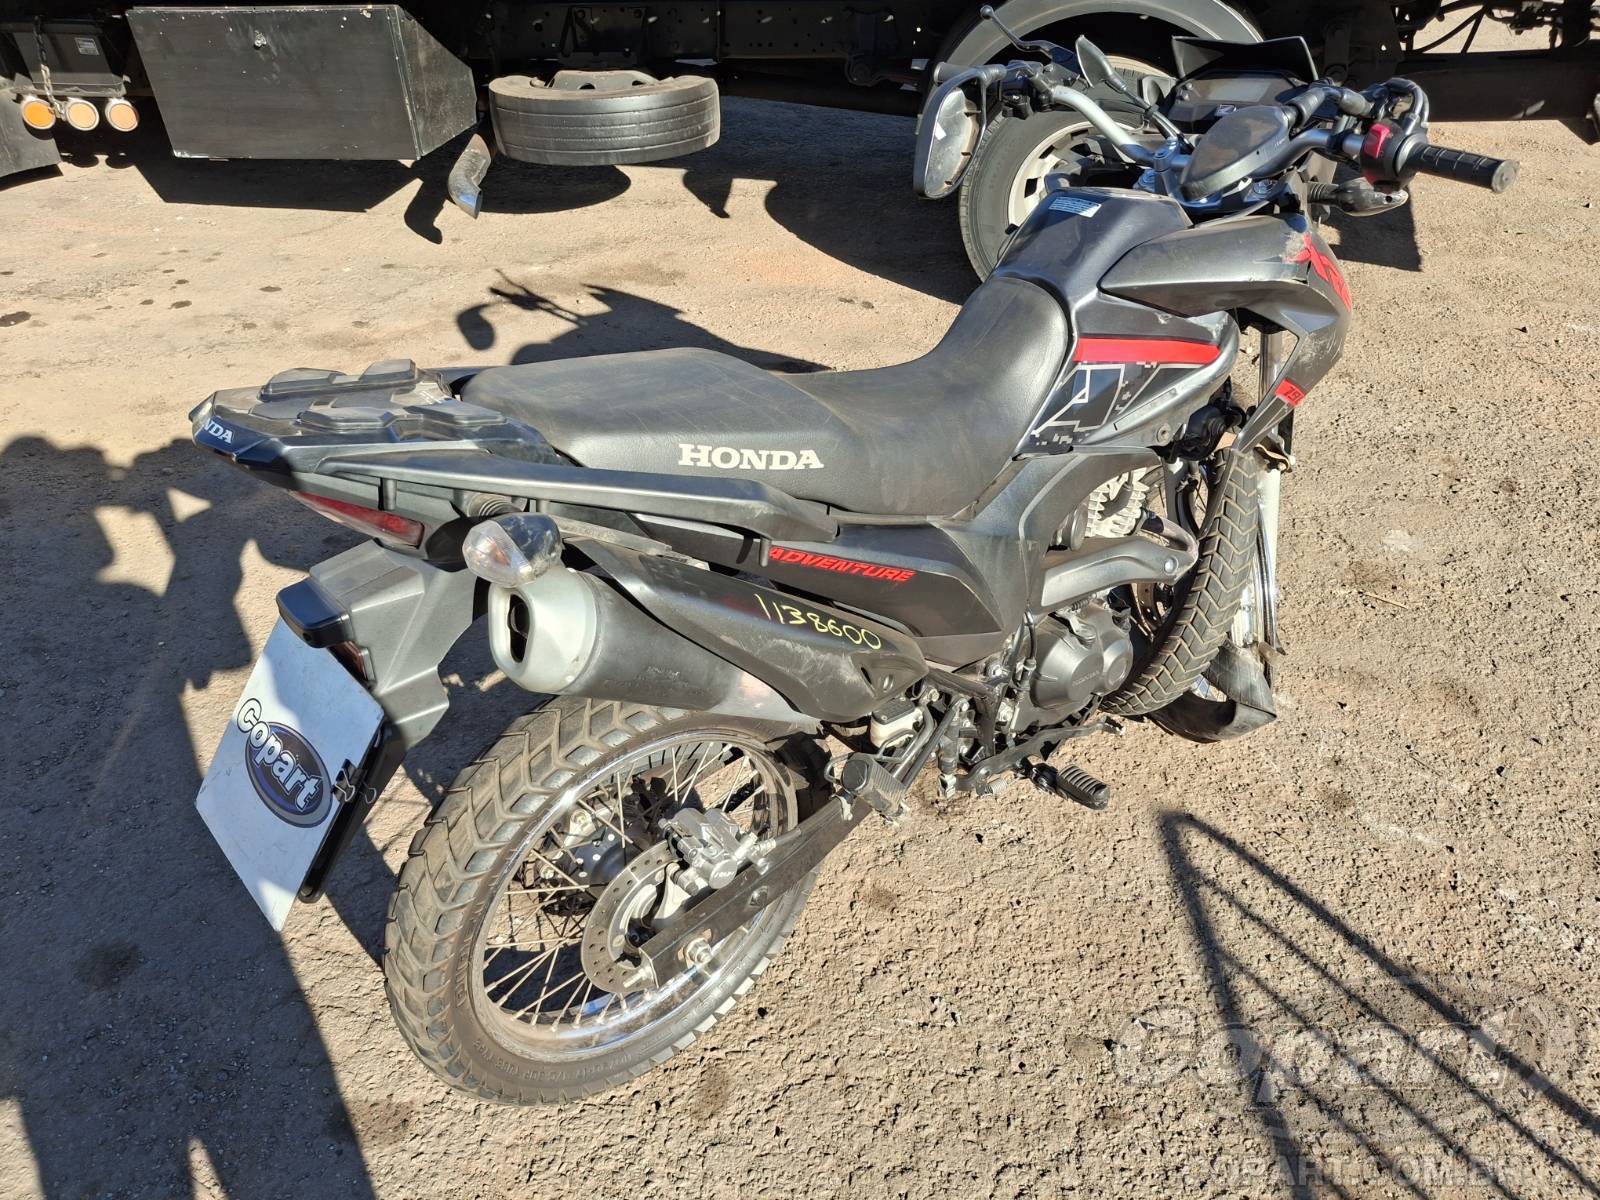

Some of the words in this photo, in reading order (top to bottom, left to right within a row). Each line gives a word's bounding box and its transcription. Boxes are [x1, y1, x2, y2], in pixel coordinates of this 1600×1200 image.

[204, 417, 233, 443] NDA
[679, 444, 823, 469] HONDA
[769, 546, 916, 582] ADVENTURE
[754, 593, 882, 650] 1138600
[237, 698, 323, 812] Copart
